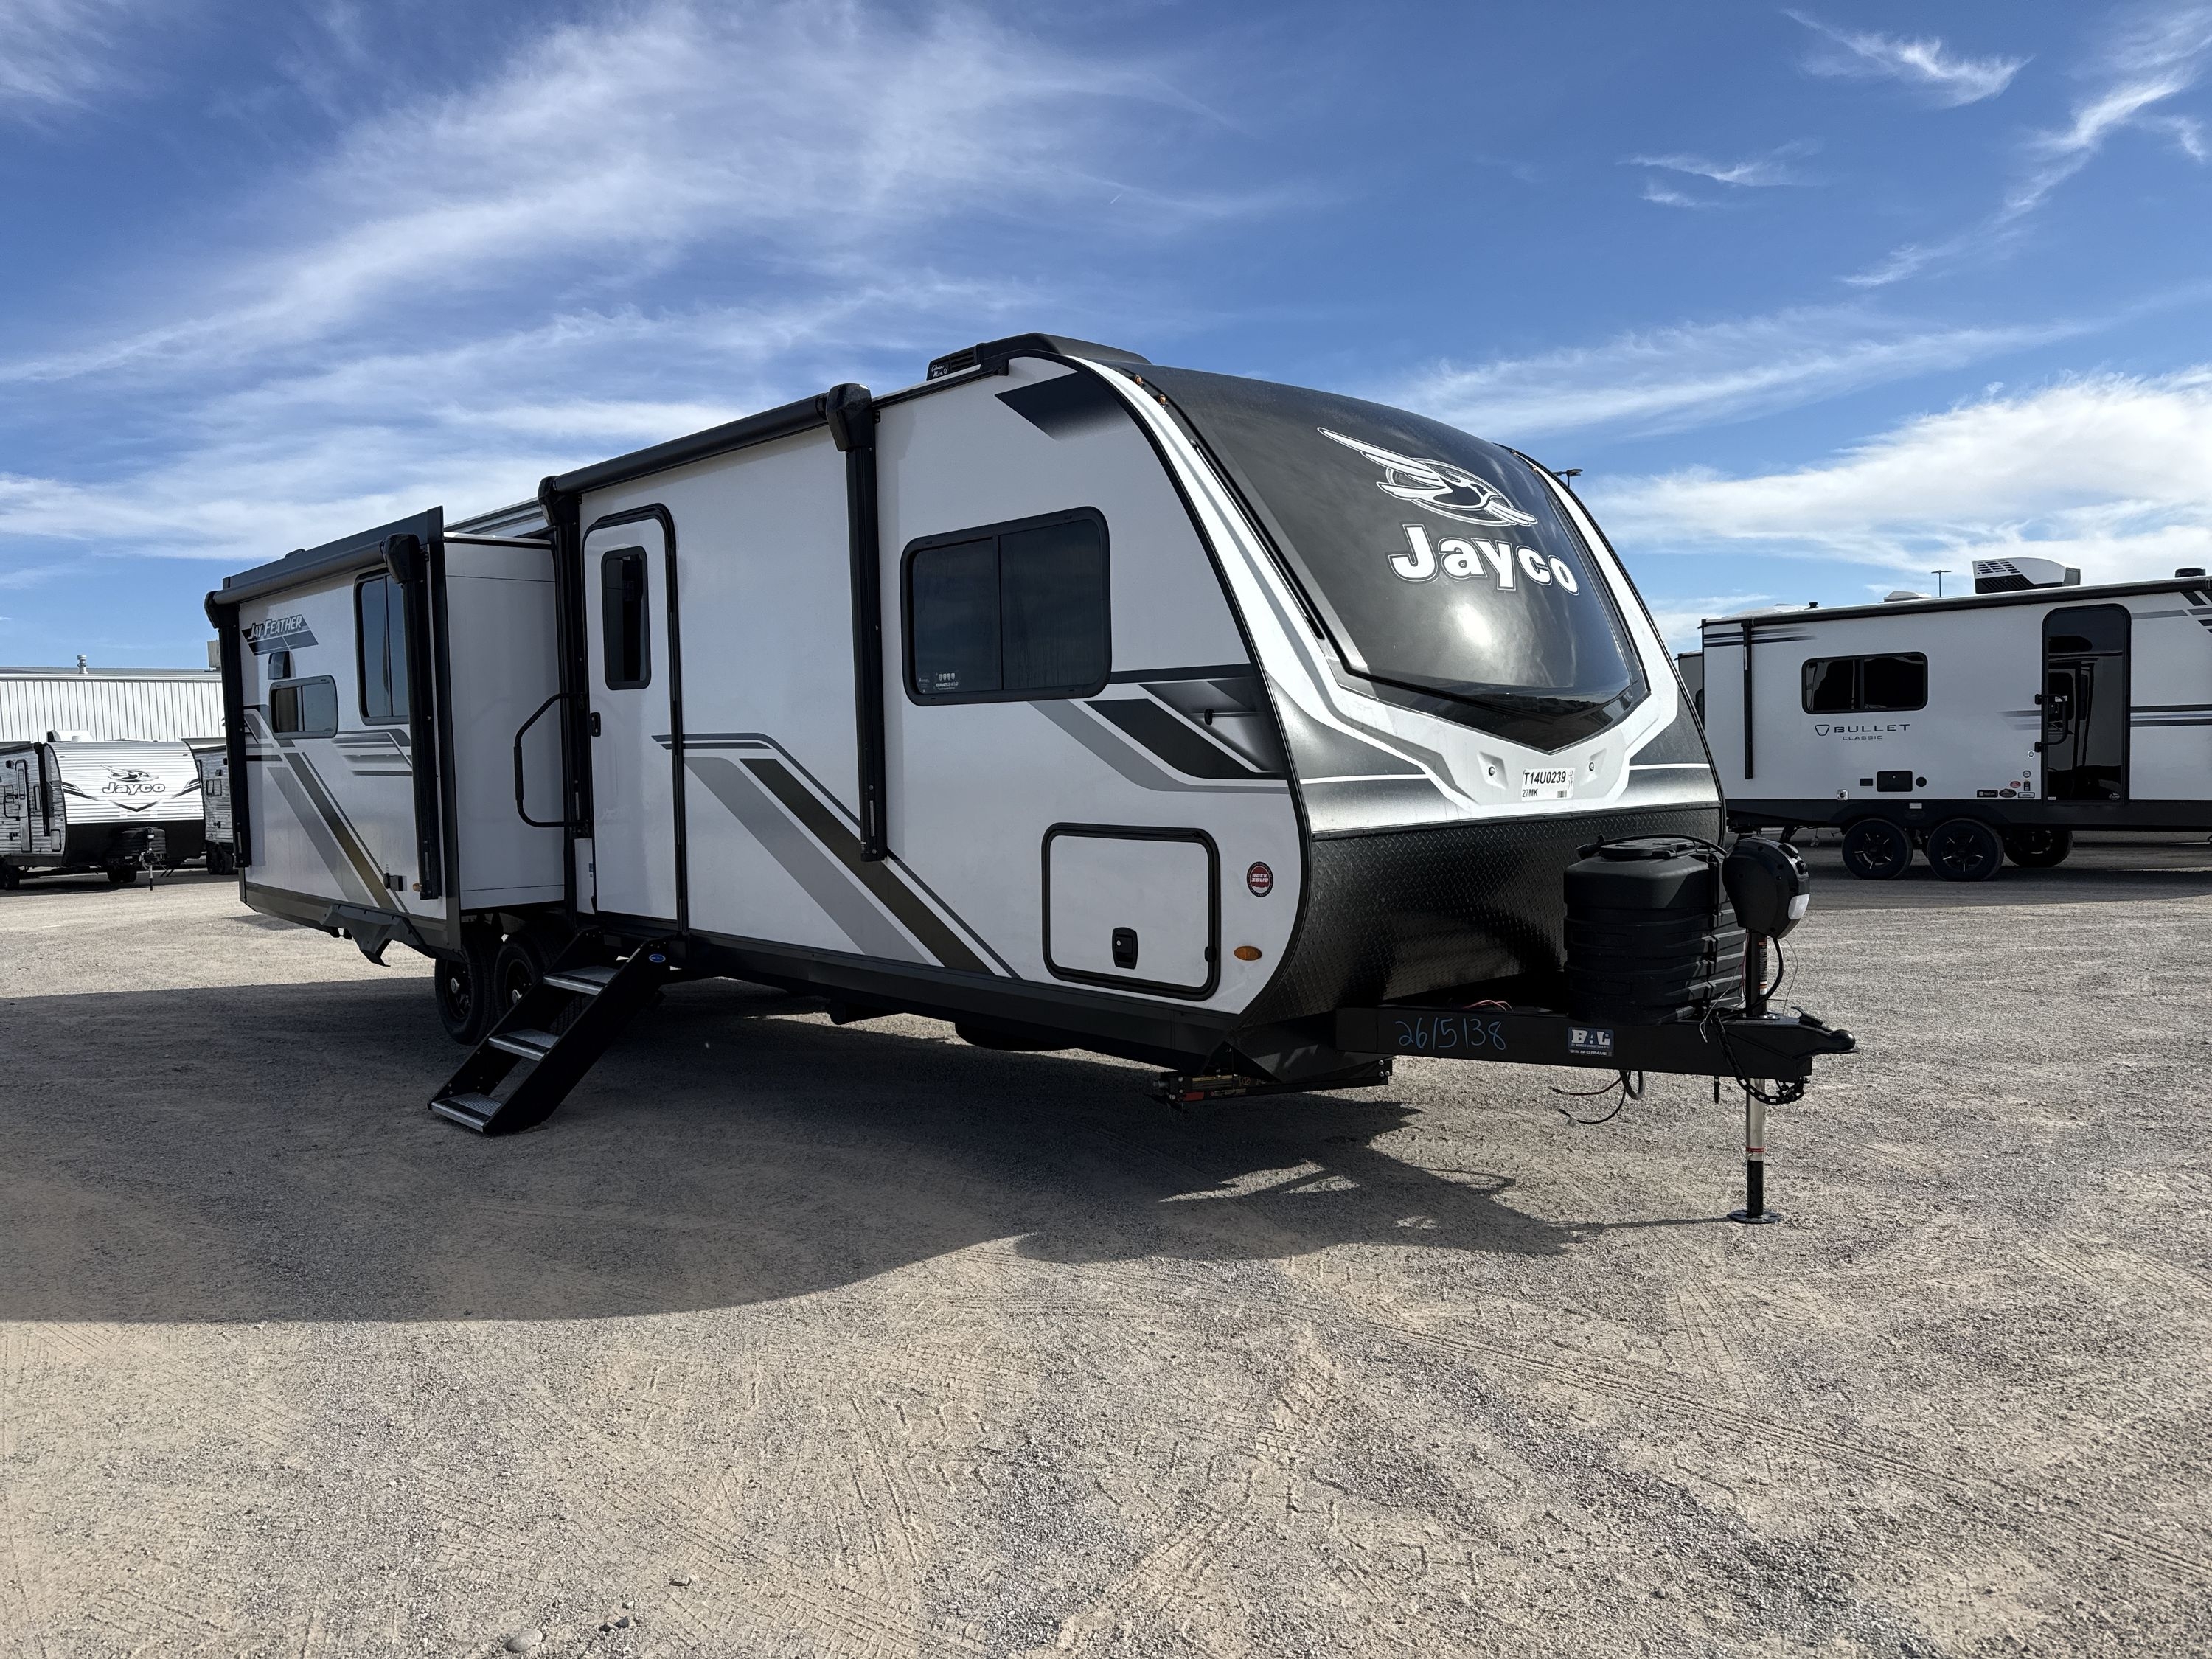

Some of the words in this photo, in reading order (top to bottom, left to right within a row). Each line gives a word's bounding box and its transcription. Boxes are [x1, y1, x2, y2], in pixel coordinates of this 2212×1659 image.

[1388, 524, 1579, 595] Jayco
[248, 623, 263, 640] JAY
[264, 615, 302, 636] FEATHER
[1834, 724, 1910, 733] BULLET
[1524, 771, 1566, 785] T14U0239
[102, 782, 165, 795] Jayco
[1522, 788, 1538, 797] 27MK
[1571, 1029, 1610, 1046] BAL
